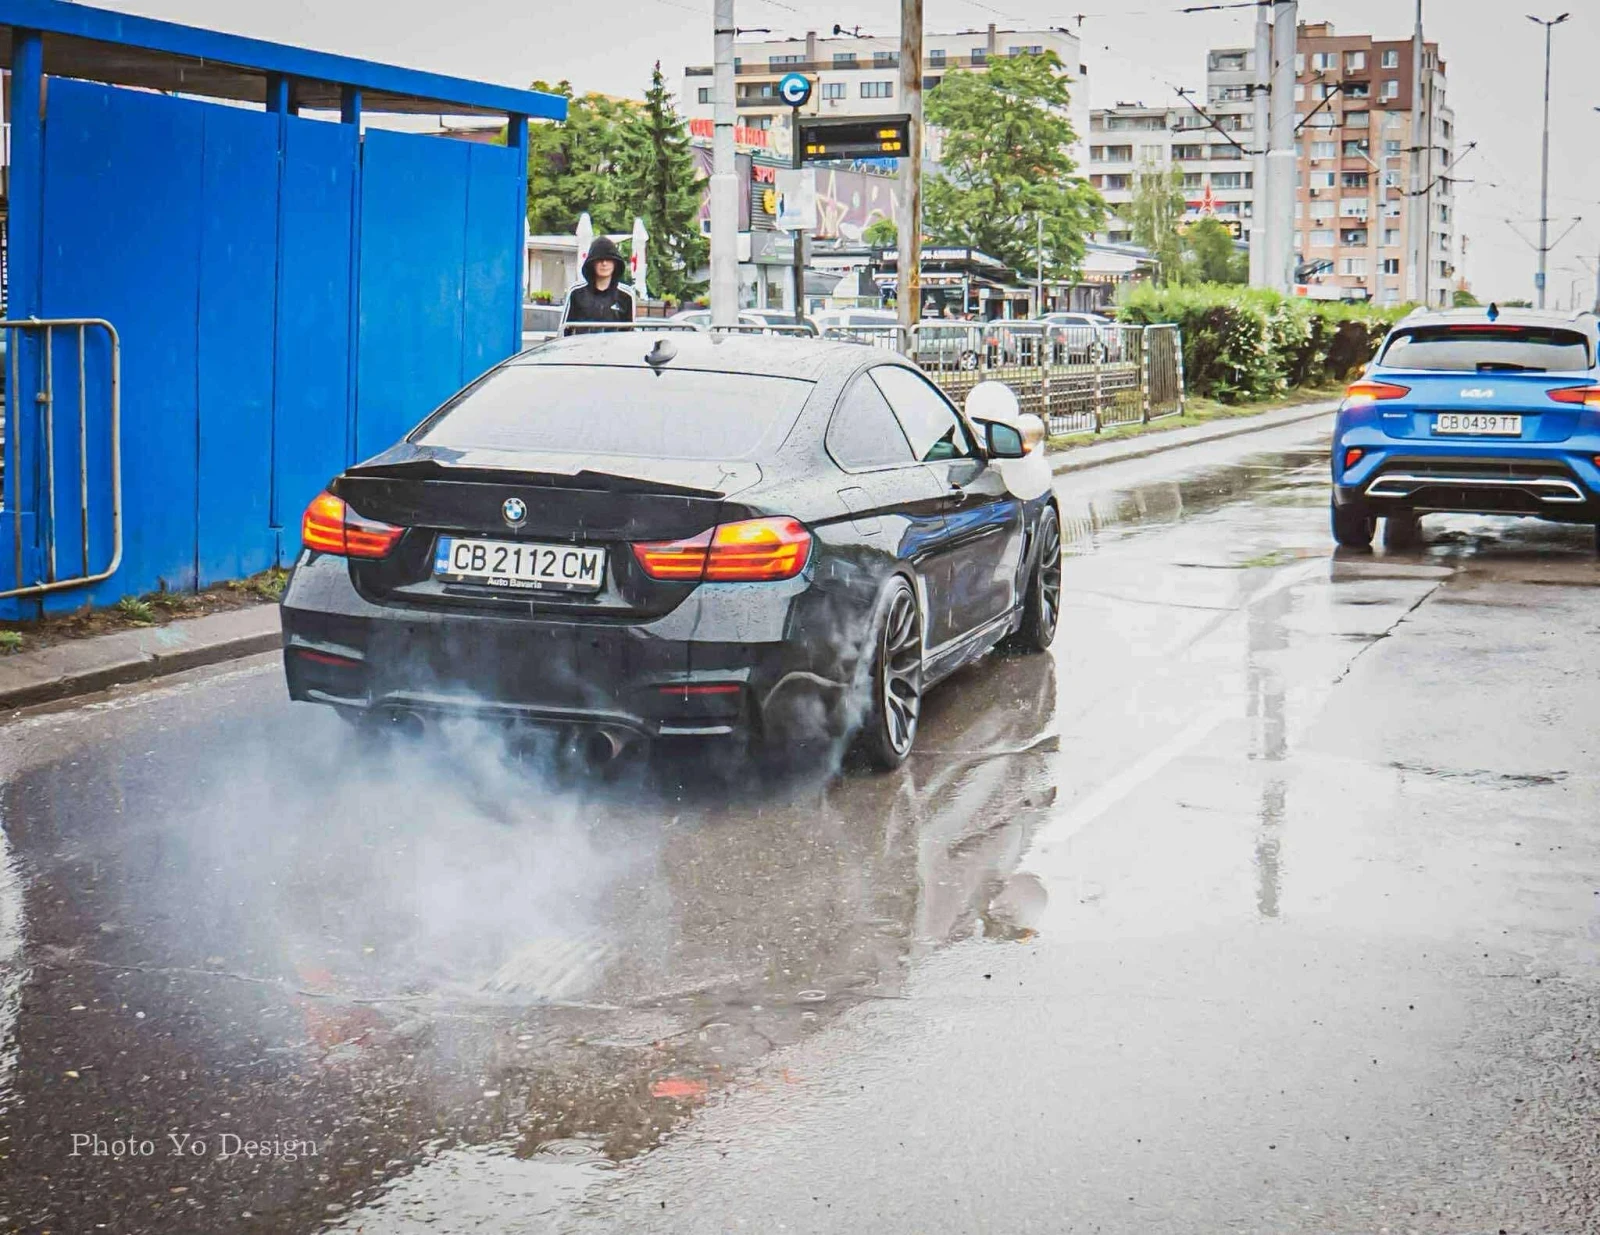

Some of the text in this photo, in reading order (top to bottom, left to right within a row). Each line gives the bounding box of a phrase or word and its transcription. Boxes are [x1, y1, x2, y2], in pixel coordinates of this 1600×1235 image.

[753, 165, 775, 184] SPO
[1440, 415, 1459, 429] CB
[1462, 416, 1497, 430] 0439
[1500, 417, 1519, 431] TT
[454, 543, 598, 581] CB 2112 CM
[487, 576, 543, 589] Auto Bavaria
